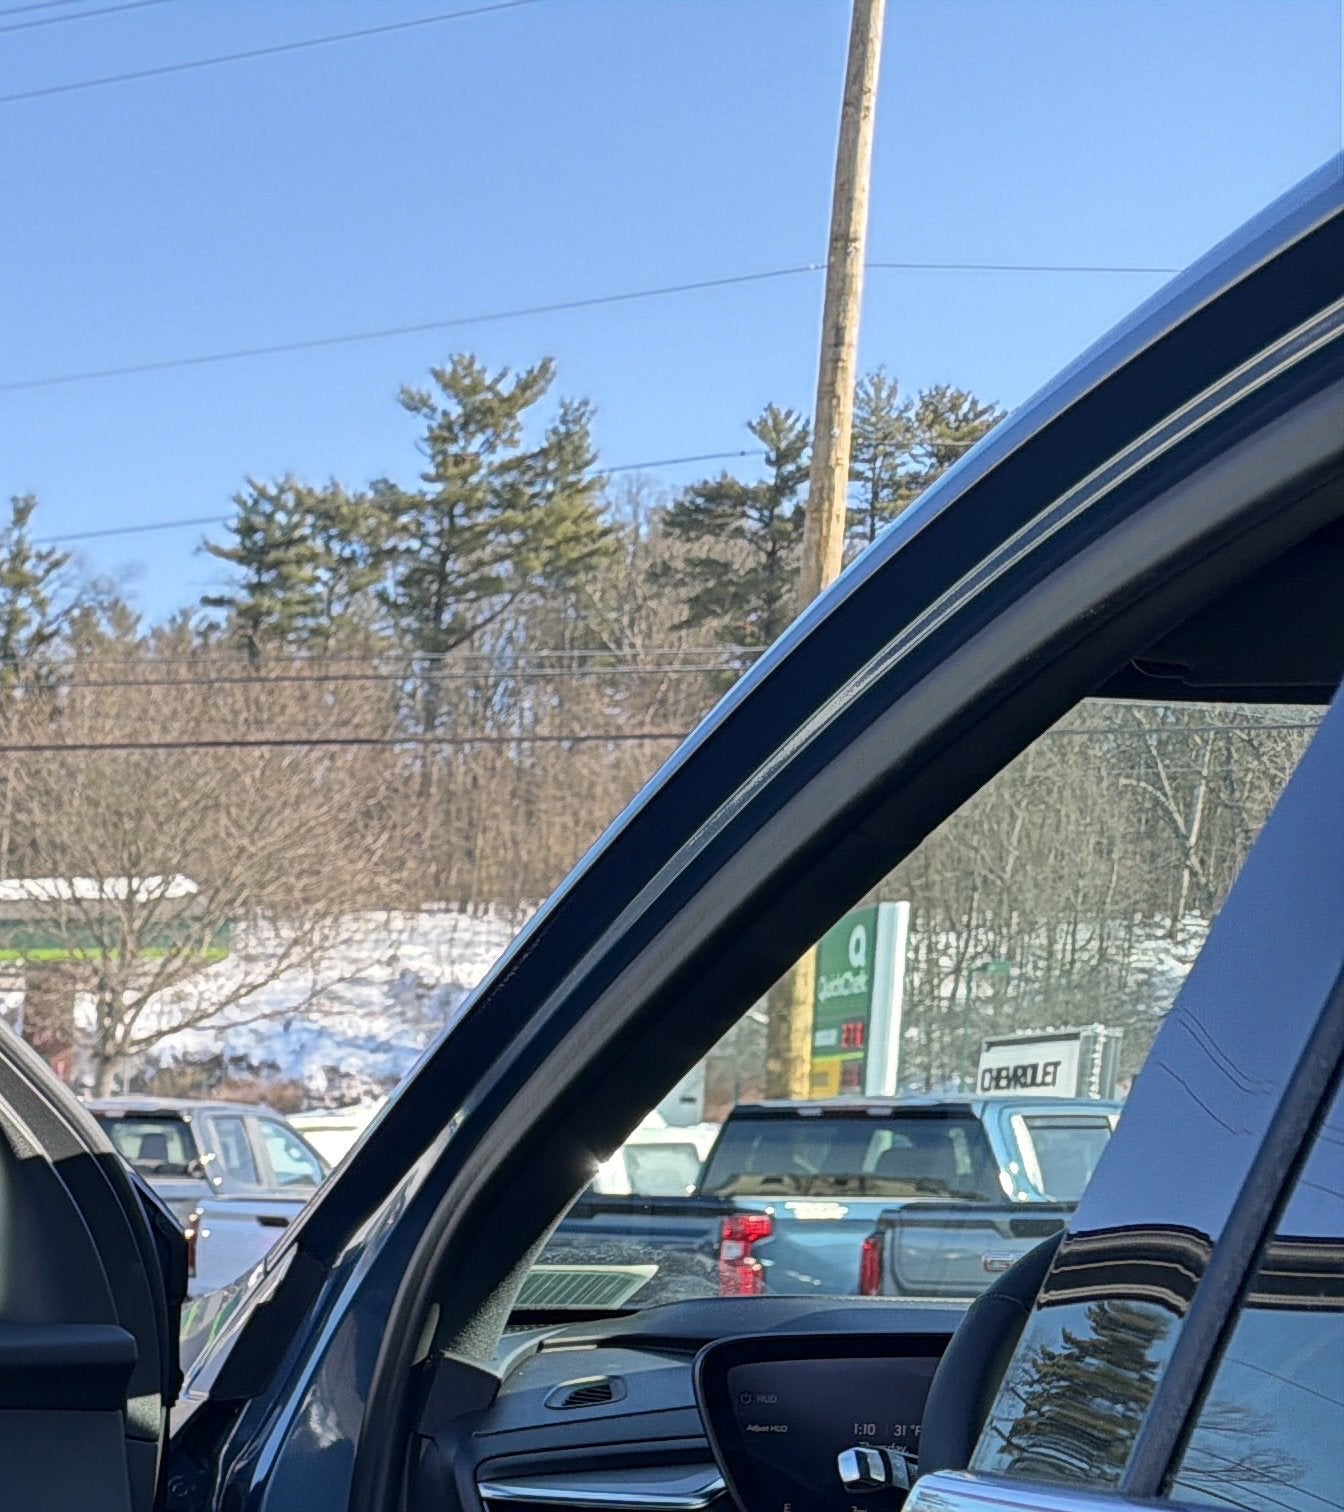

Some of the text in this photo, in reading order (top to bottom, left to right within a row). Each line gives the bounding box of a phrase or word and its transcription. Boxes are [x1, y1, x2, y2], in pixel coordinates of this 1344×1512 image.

[980, 1060, 1062, 1093] CHEVROLET
[756, 1395, 778, 1404] HUD
[746, 1423, 788, 1433] Adjust HUD
[853, 1422, 876, 1436] 1:10
[893, 1424, 907, 1437] 31
